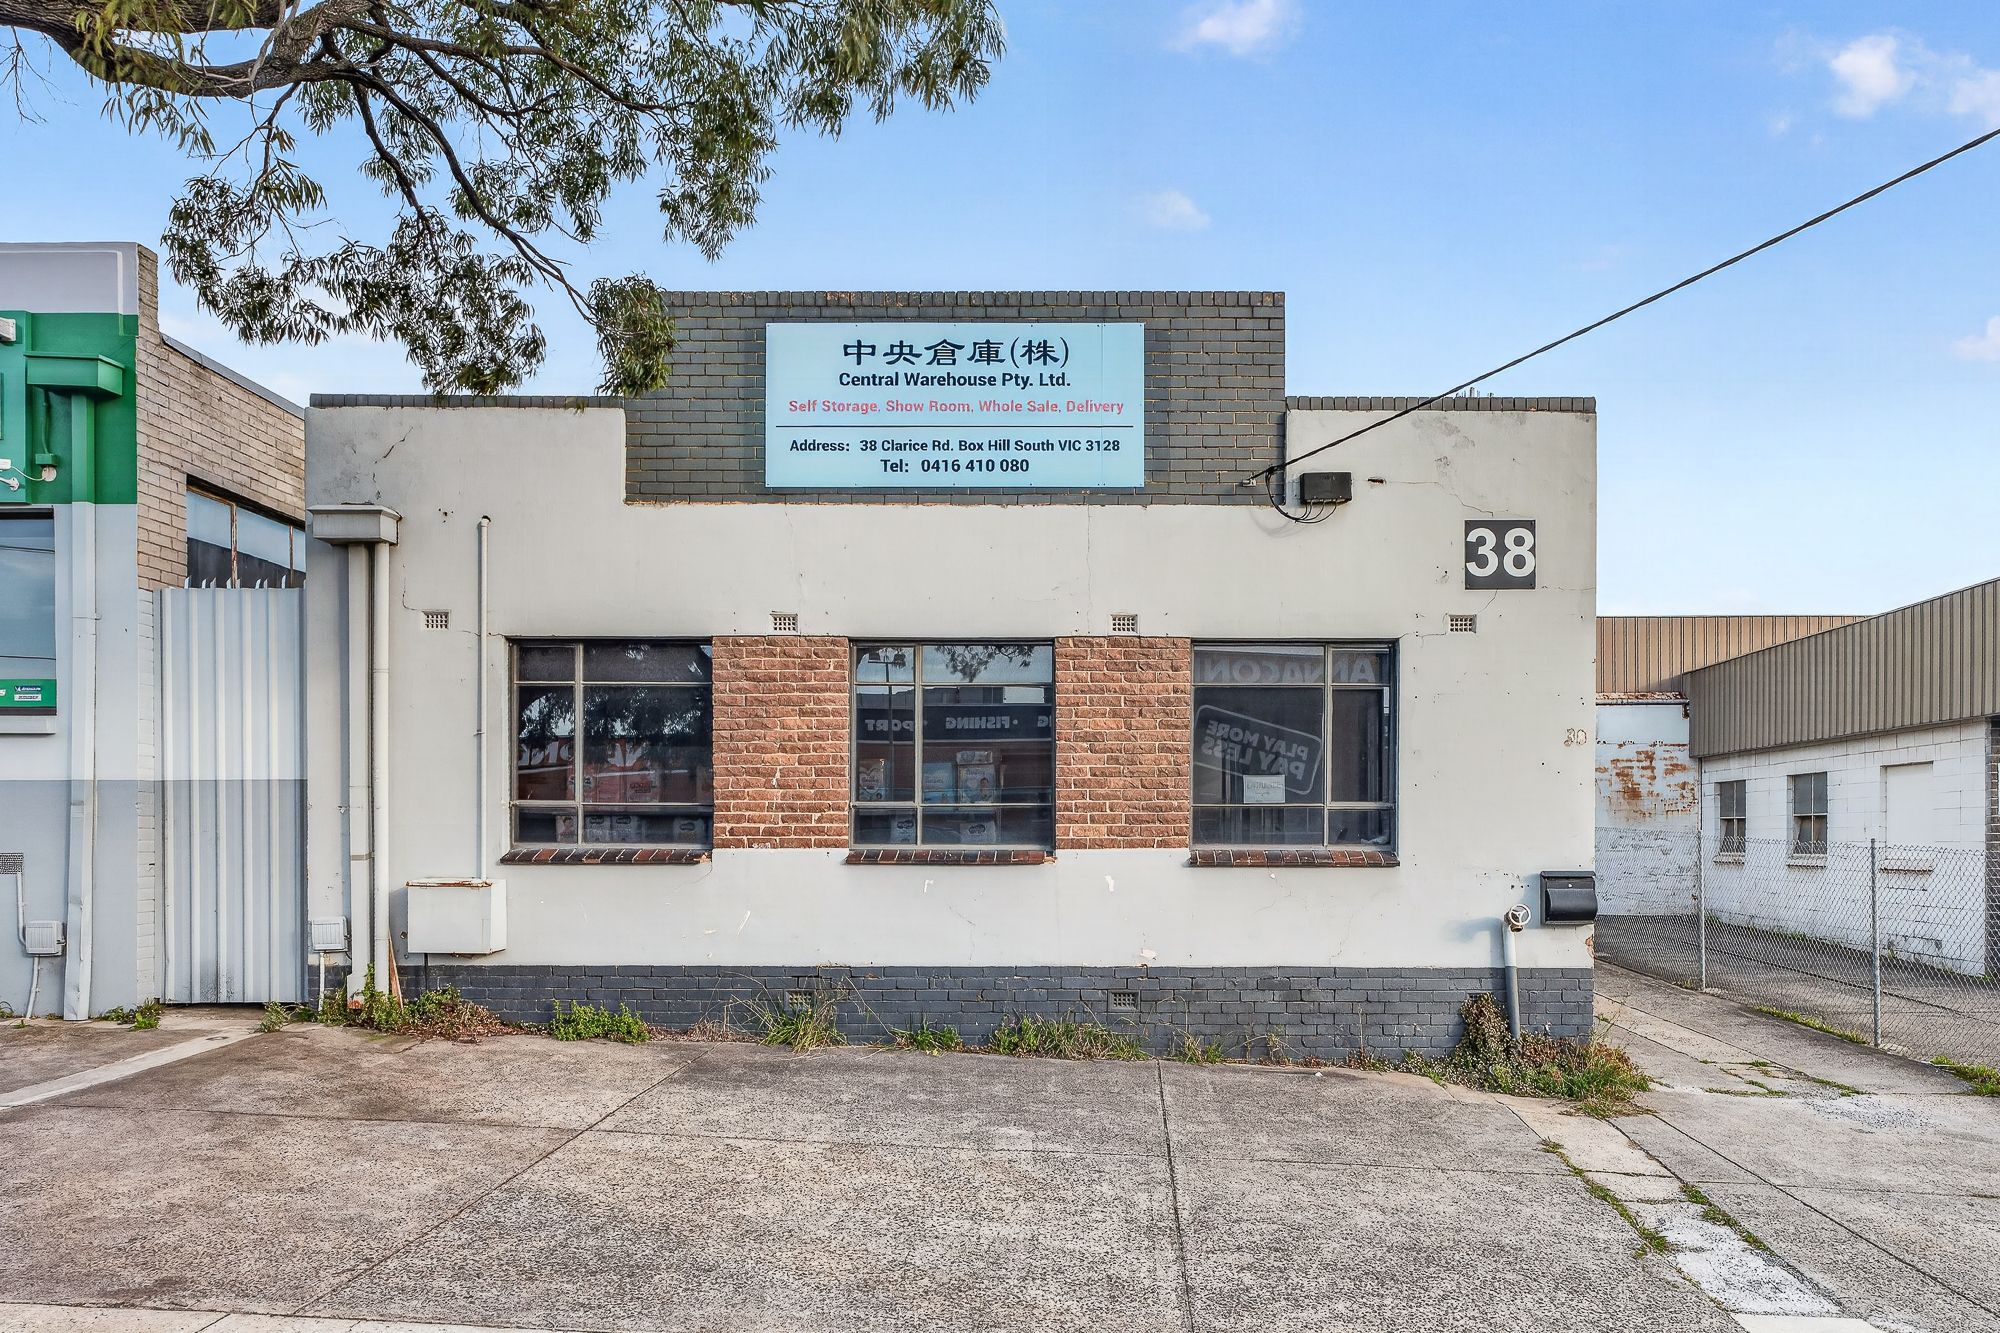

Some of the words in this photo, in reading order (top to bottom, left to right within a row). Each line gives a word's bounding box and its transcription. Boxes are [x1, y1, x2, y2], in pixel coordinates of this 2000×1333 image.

[842, 336, 1070, 369] 中央倉庫(株)
[838, 371, 899, 387] Central
[904, 371, 997, 387] Warehouse
[1001, 372, 1034, 389] Pty.
[1039, 371, 1071, 387] Ltd.
[788, 399, 818, 414] Self
[886, 399, 924, 413] Show
[978, 399, 1022, 413] Whole
[1027, 399, 1061, 415] Sale,
[1066, 399, 1124, 416] Delivery
[789, 438, 850, 452] Address:
[859, 439, 878, 452] 38
[881, 438, 928, 452] Clarice
[931, 439, 954, 452] Rd.
[958, 439, 984, 452] Box
[988, 438, 1011, 452] Hill
[1014, 438, 1055, 452] South
[1057, 439, 1082, 452] VIC
[1084, 439, 1121, 452] 3128
[880, 458, 909, 473] Tel:
[920, 458, 961, 473] 0416
[965, 458, 995, 473] 410
[999, 458, 1030, 473] 080
[1466, 527, 1536, 578] 38
